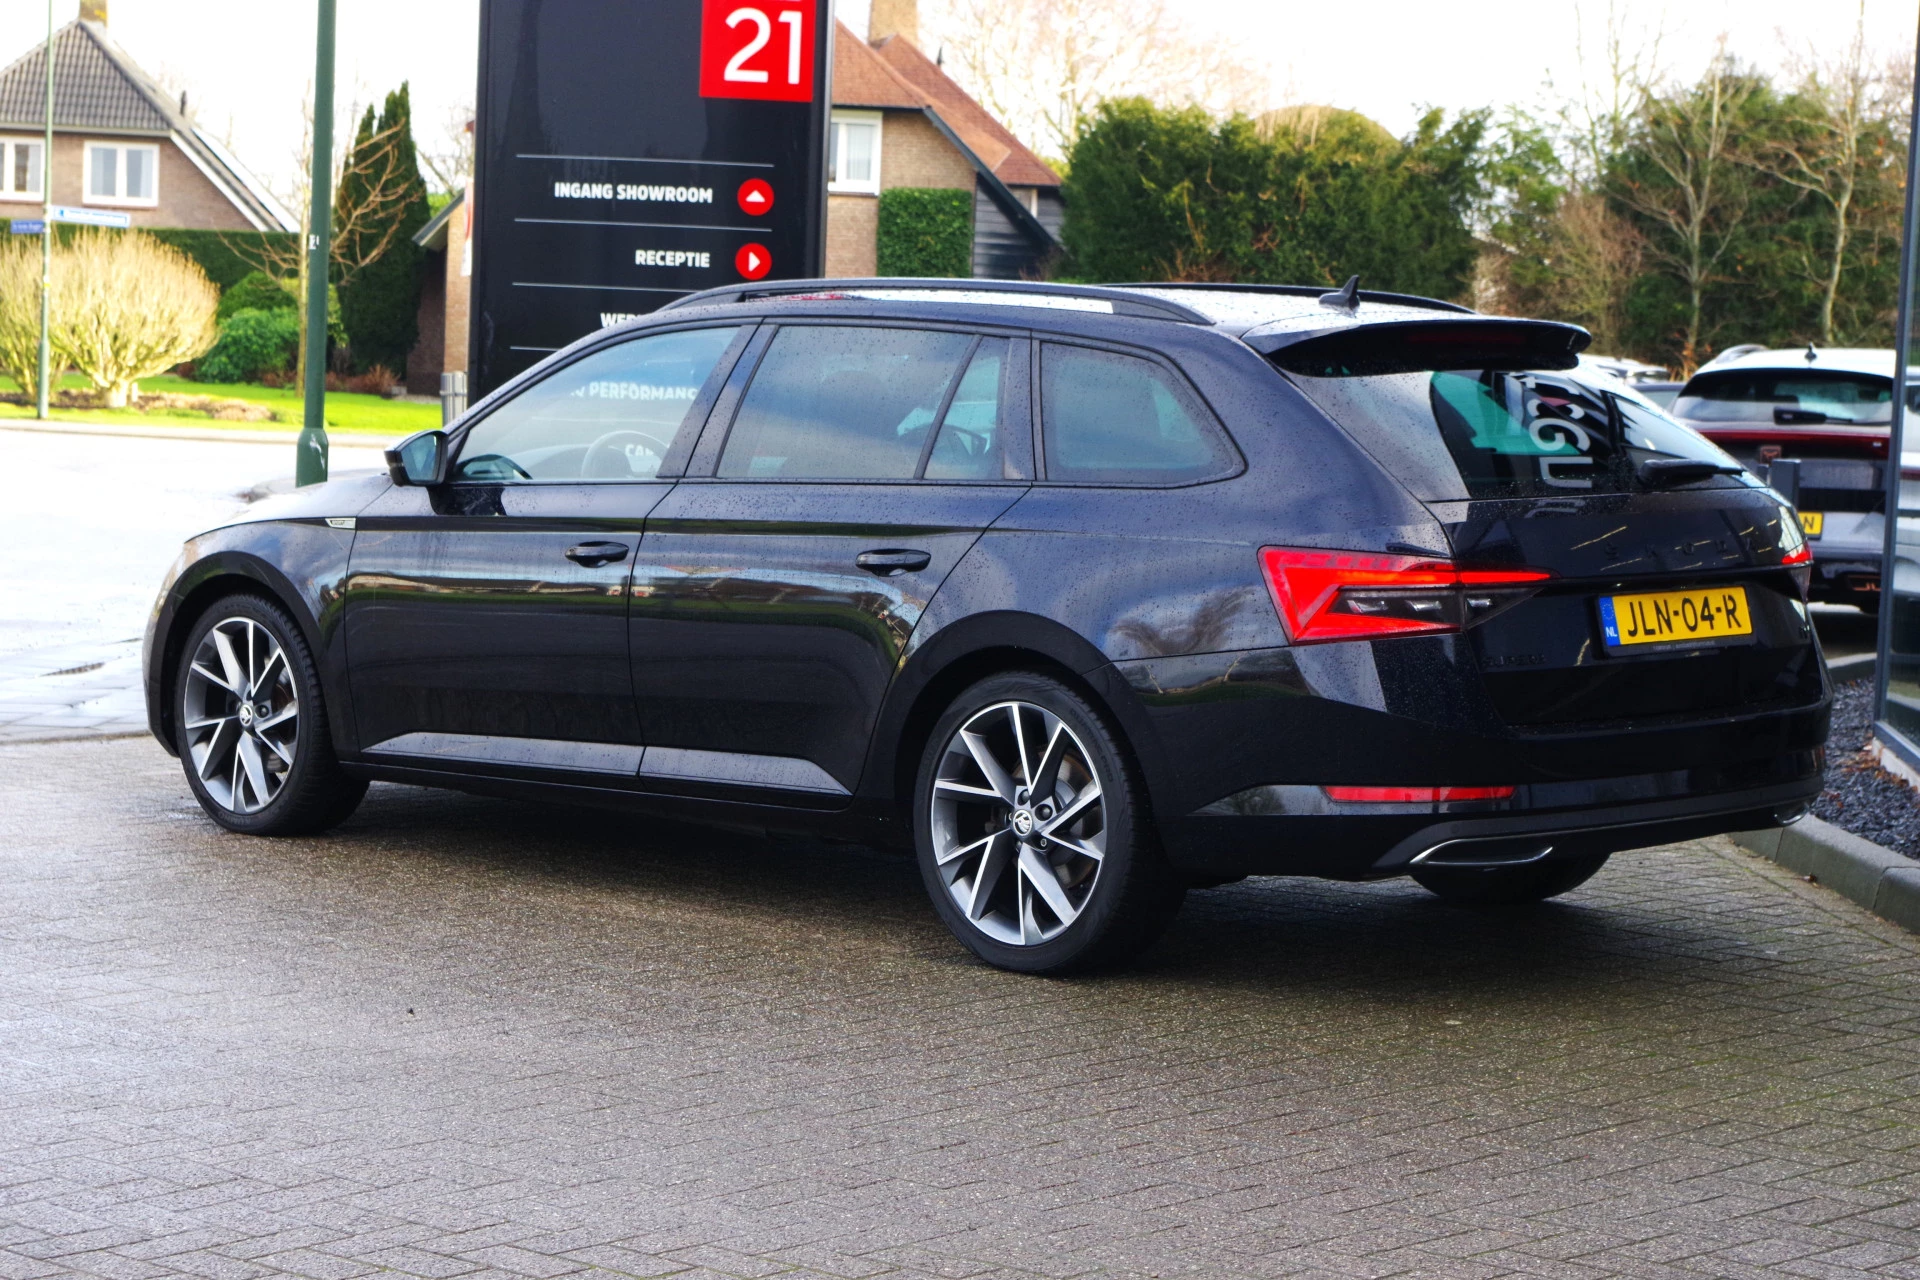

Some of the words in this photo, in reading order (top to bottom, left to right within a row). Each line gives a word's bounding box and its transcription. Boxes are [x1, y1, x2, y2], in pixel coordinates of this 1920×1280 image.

[724, 7, 802, 85] 21
[554, 182, 613, 200] INGANG
[616, 184, 713, 203] SHOWROOM
[635, 249, 710, 268] RECEPTIE
[1628, 594, 1741, 637] JLN-04-R
[1605, 626, 1617, 638] NL
